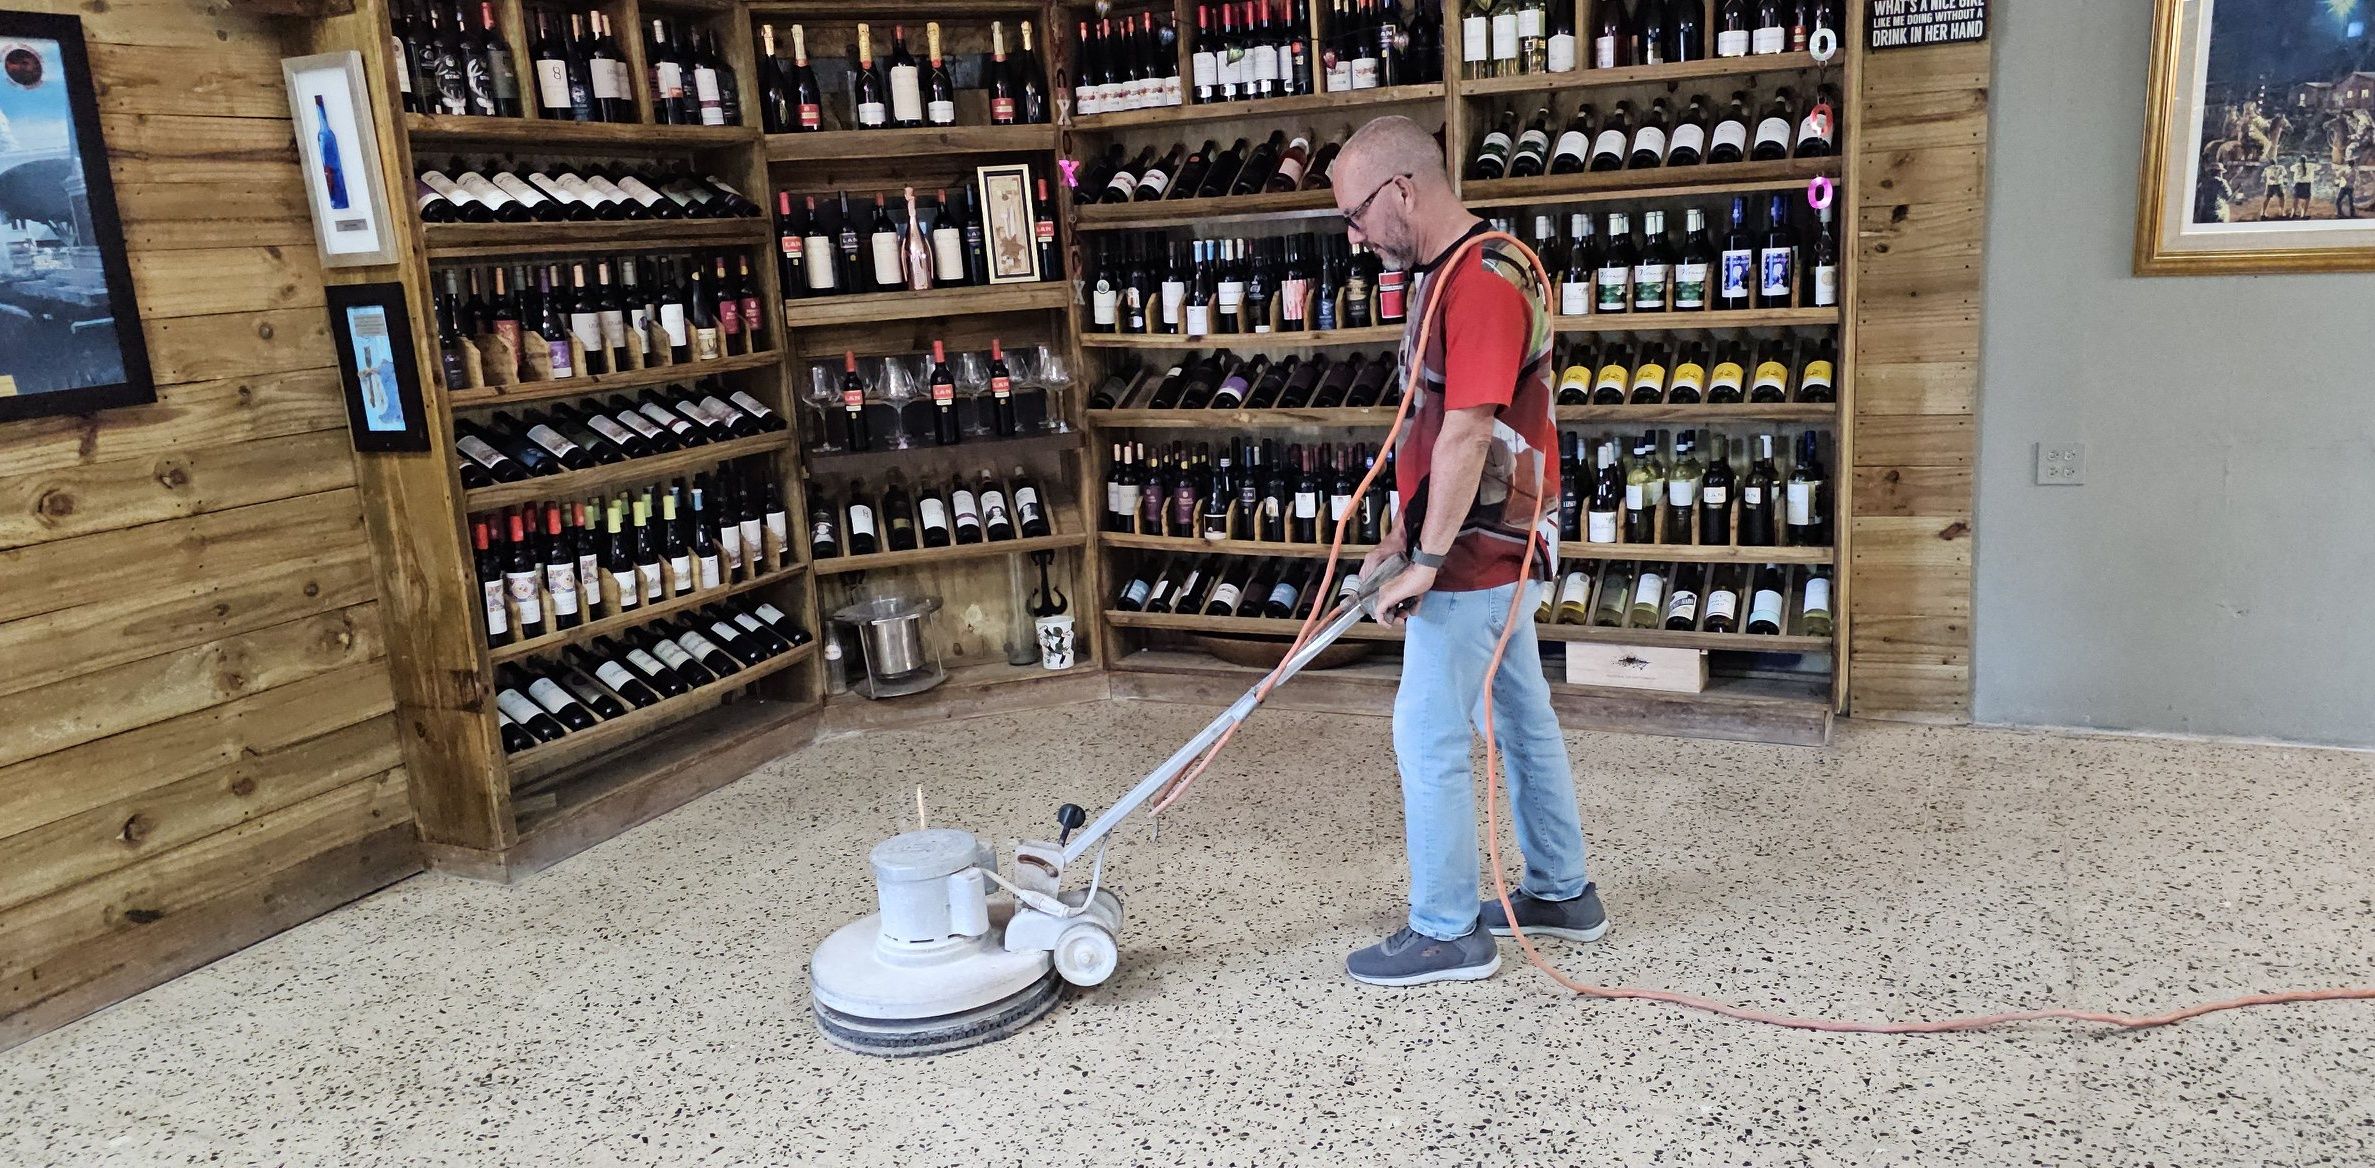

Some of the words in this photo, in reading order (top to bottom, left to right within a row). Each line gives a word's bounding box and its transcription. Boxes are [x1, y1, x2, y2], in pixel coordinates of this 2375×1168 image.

[1873, 17, 1891, 28] LIKE
[1892, 15, 1905, 26] ME
[1907, 13, 1933, 25] DOING
[1935, 8, 1974, 22] WITHOUT
[1976, 7, 1983, 18] A
[1874, 0, 1917, 16] WHAT'S
[1920, 0, 1927, 11] A
[1930, 0, 1956, 11] NICE
[1872, 28, 1908, 47] DRINK
[1910, 26, 1922, 43] IN
[1924, 23, 1948, 42] HER
[1950, 20, 1984, 40] HAND
[553, 66, 561, 80] 8
[1058, 159, 1080, 188] X
